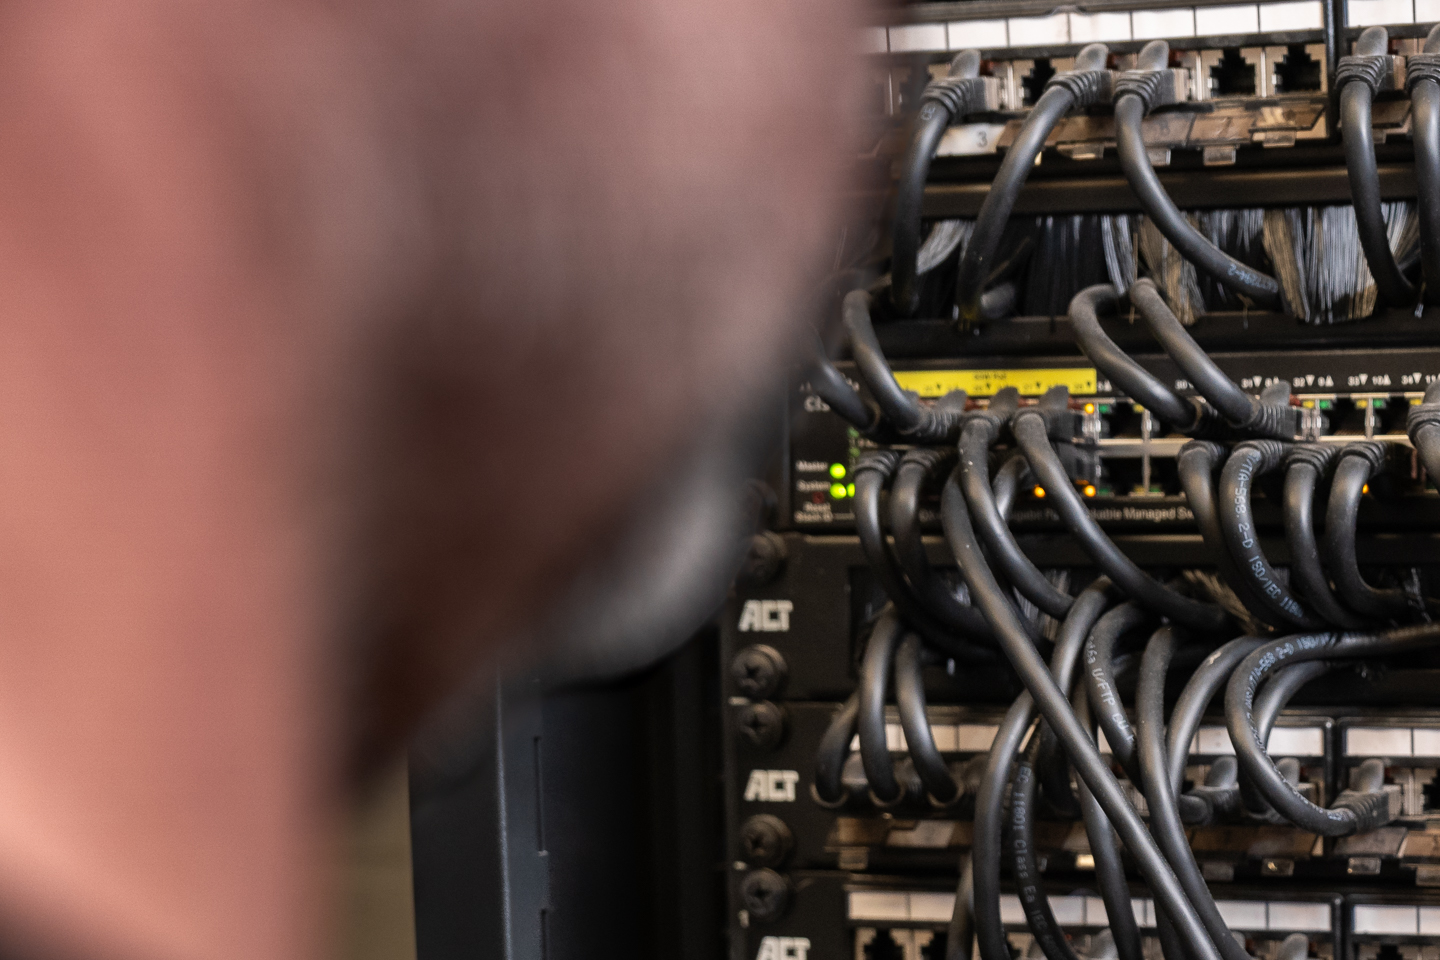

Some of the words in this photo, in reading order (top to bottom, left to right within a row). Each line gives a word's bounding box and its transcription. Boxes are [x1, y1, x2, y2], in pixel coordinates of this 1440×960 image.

[1249, 555, 1282, 600] ISO/IEC
[738, 600, 794, 632] ACT
[1091, 667, 1116, 707] U/FTP
[744, 769, 799, 802] ACT
